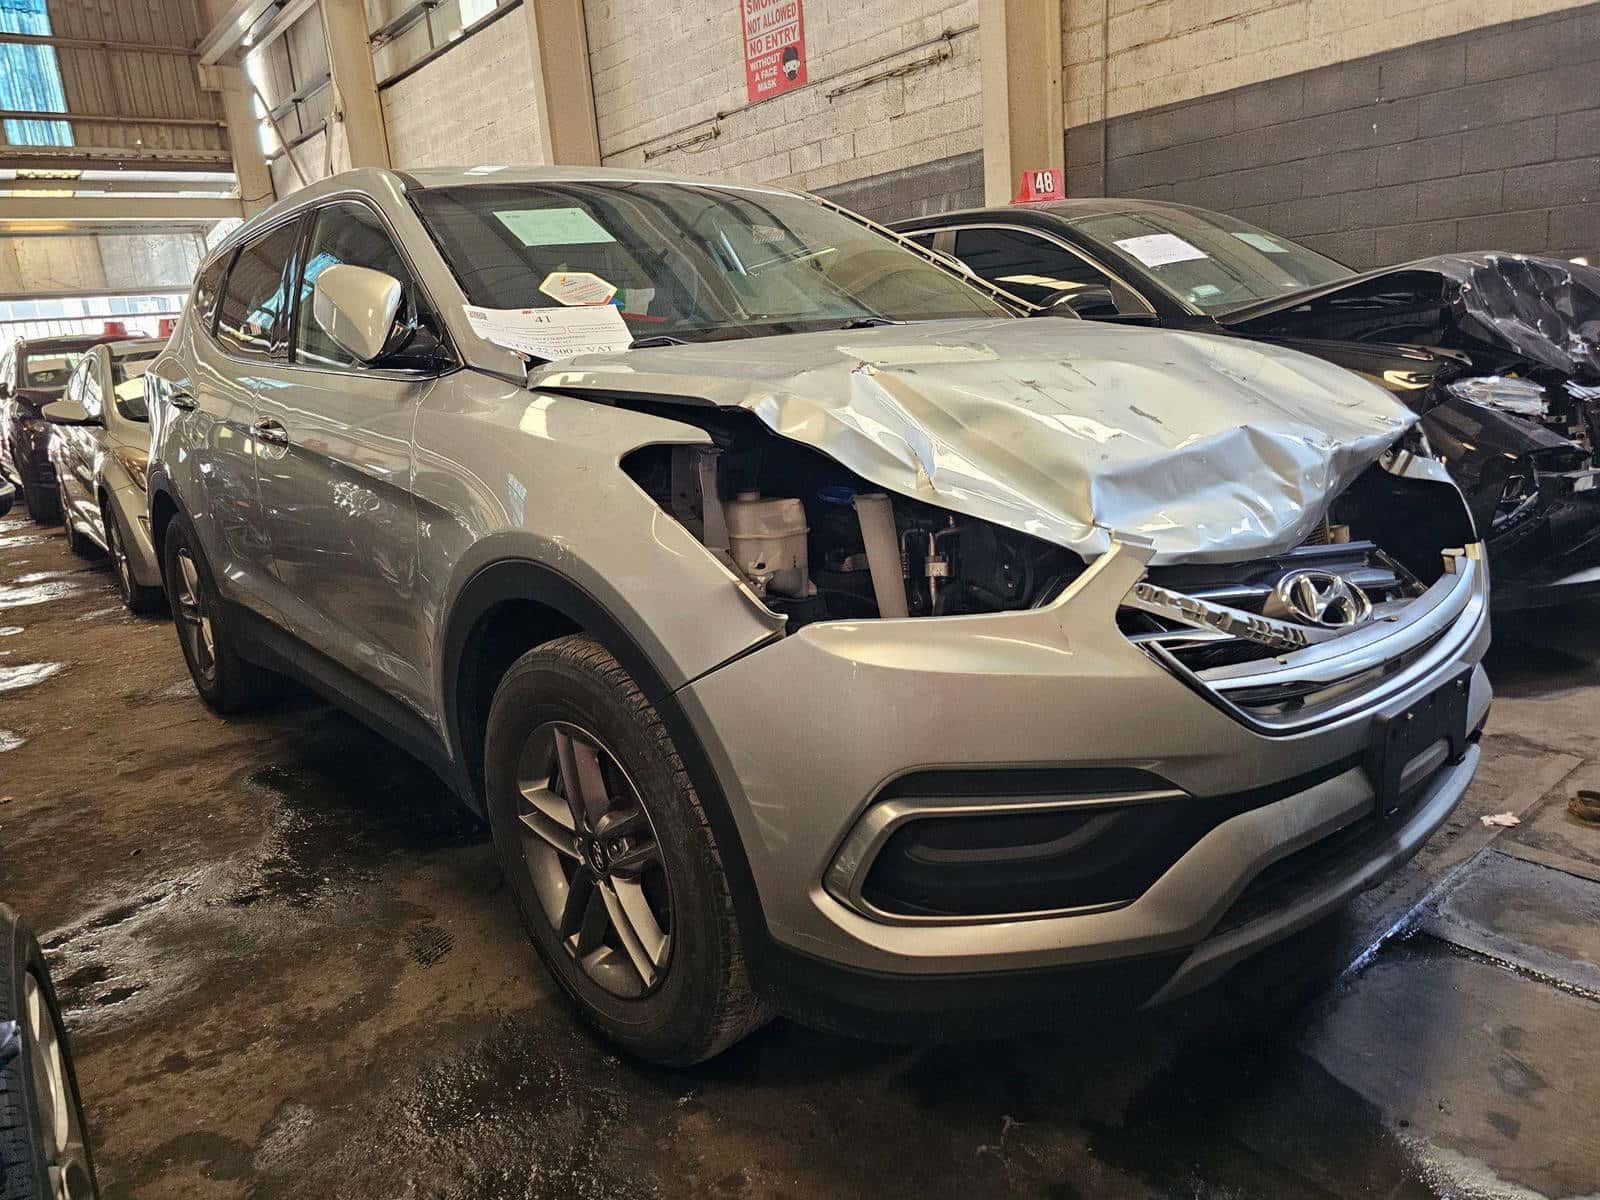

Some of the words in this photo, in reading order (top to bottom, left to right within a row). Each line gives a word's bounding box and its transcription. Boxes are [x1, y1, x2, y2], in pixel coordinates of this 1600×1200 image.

[747, 16, 761, 35] NOT
[763, 2, 796, 28] ALLOWED
[750, 39, 762, 57] NO
[766, 25, 797, 50] ENTRY
[750, 53, 781, 71] WITHOUT
[761, 65, 778, 79] FACE
[758, 80, 777, 92] MASK
[1036, 172, 1054, 193] 48
